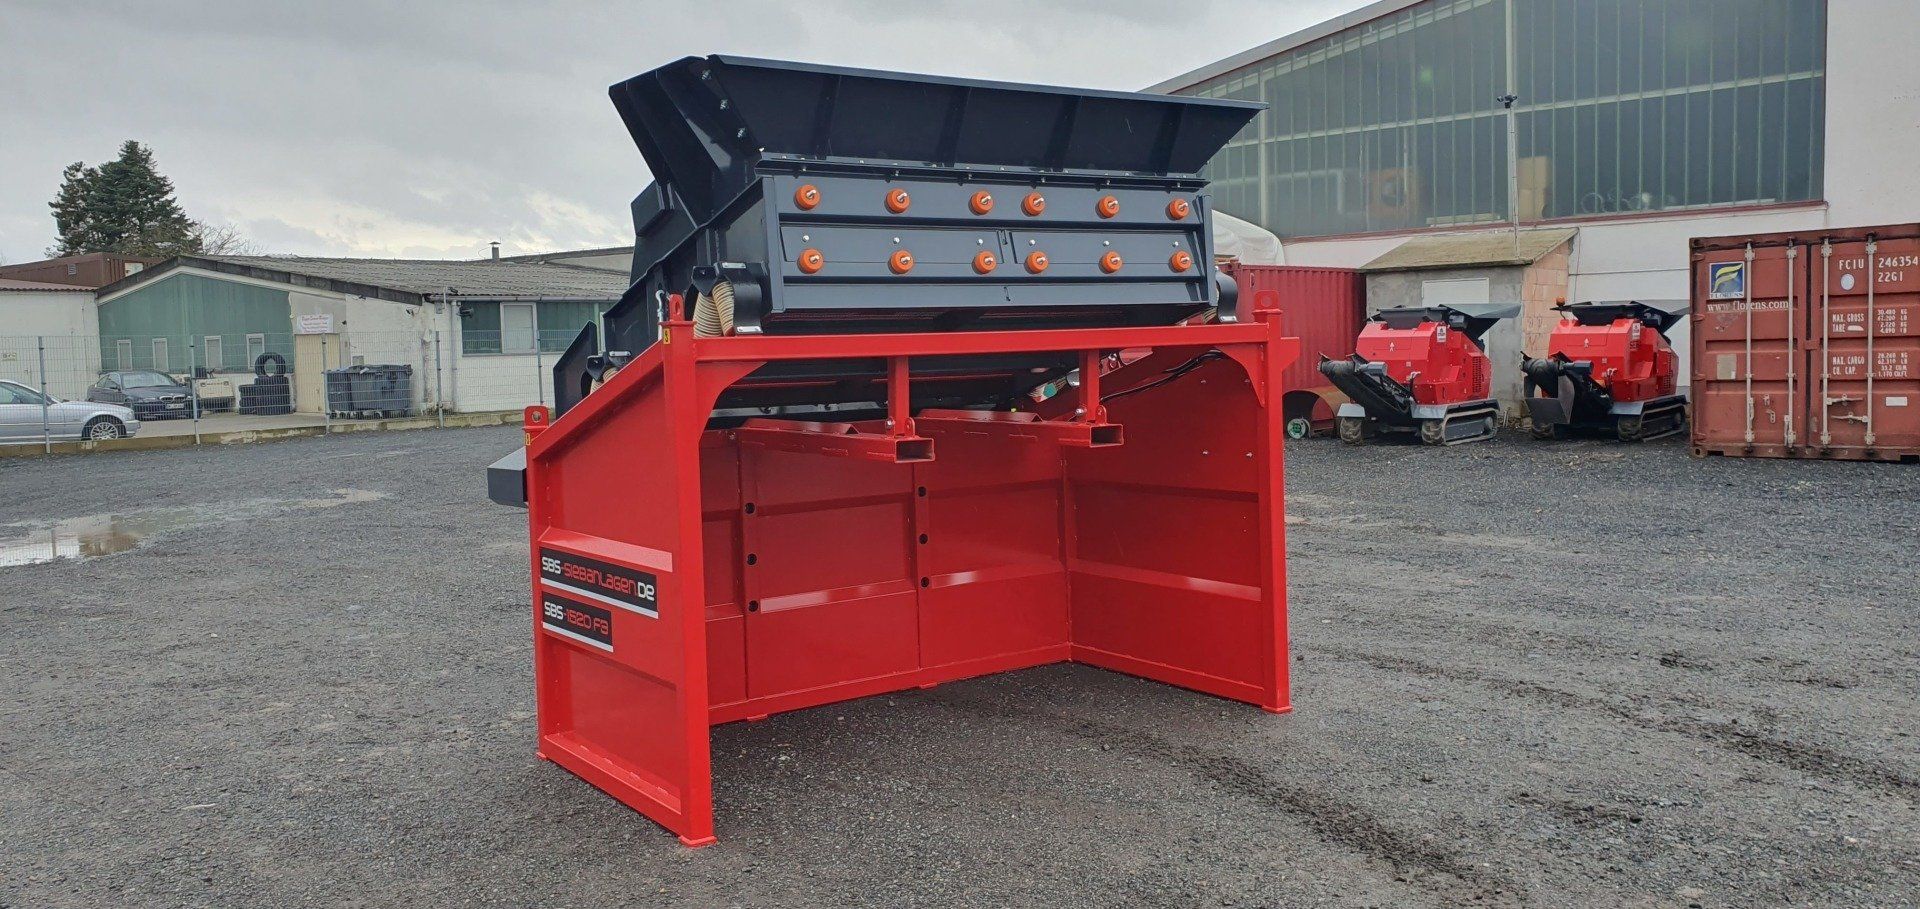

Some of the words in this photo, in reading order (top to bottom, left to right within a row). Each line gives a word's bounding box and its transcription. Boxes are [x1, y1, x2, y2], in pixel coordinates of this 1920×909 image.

[1839, 259, 1864, 270] FCIU
[1878, 255, 1919, 268] 246354
[1878, 271, 1903, 282] 22G1
[1707, 301, 1789, 312] www.floens.com
[1832, 314, 1846, 323] MAX.
[1847, 313, 1865, 322] GROSS
[1832, 324, 1846, 333] TARE
[1832, 356, 1846, 365] MAX.
[1847, 355, 1865, 365] CARGO
